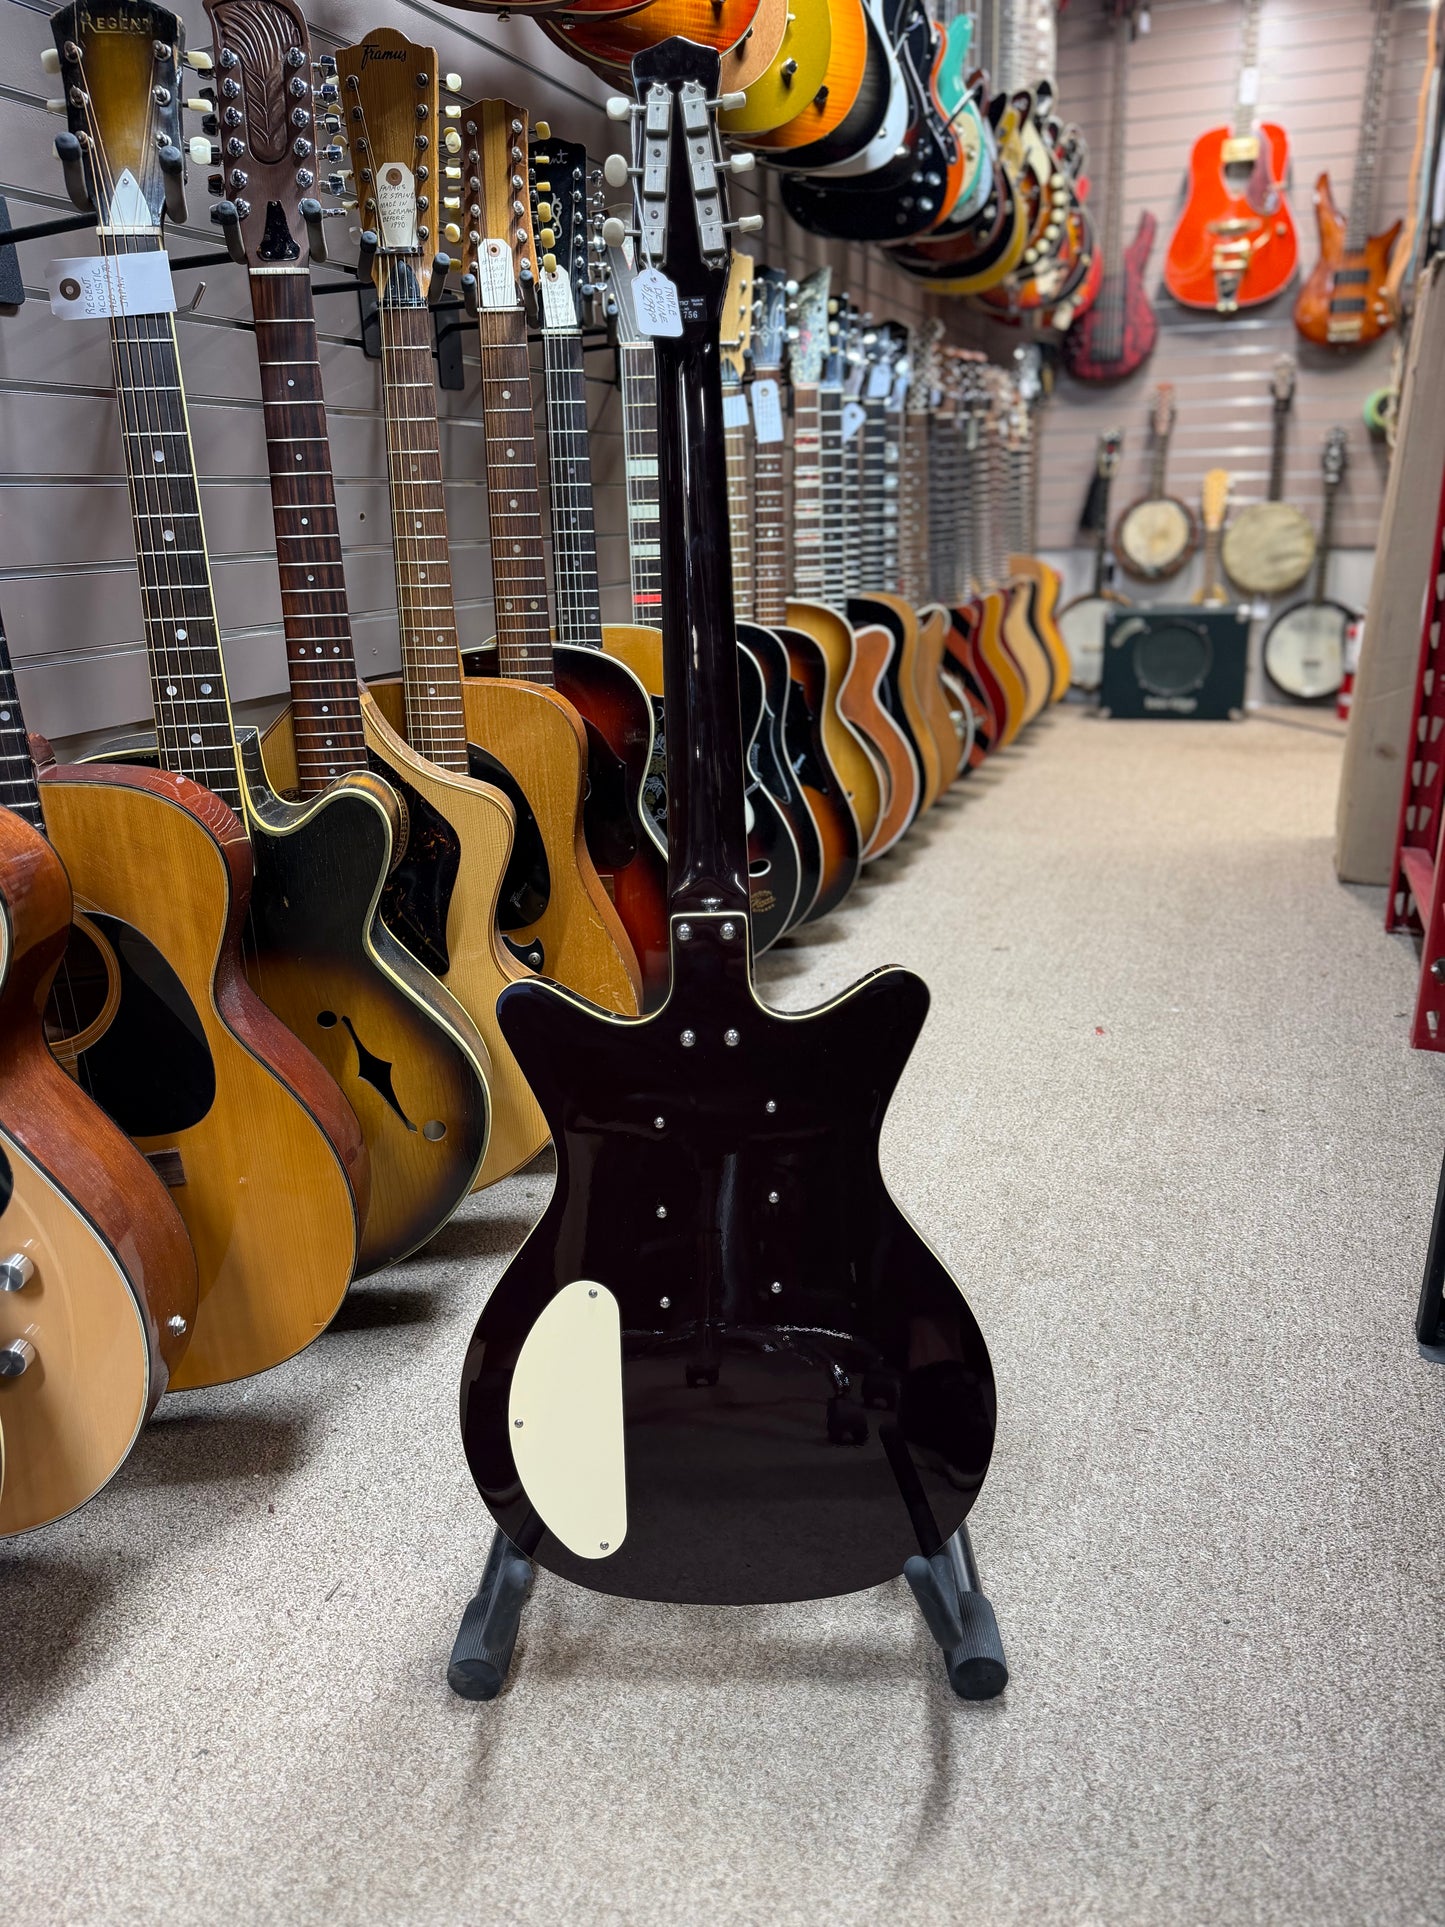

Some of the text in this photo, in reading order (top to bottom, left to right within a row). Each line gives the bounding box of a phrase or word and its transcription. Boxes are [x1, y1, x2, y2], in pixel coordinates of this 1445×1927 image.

[361, 44, 407, 71] Framus
[81, 276, 96, 315] REGENT
[92, 267, 106, 313] ACOUSTIC
[664, 286, 677, 316] TRIPLE
